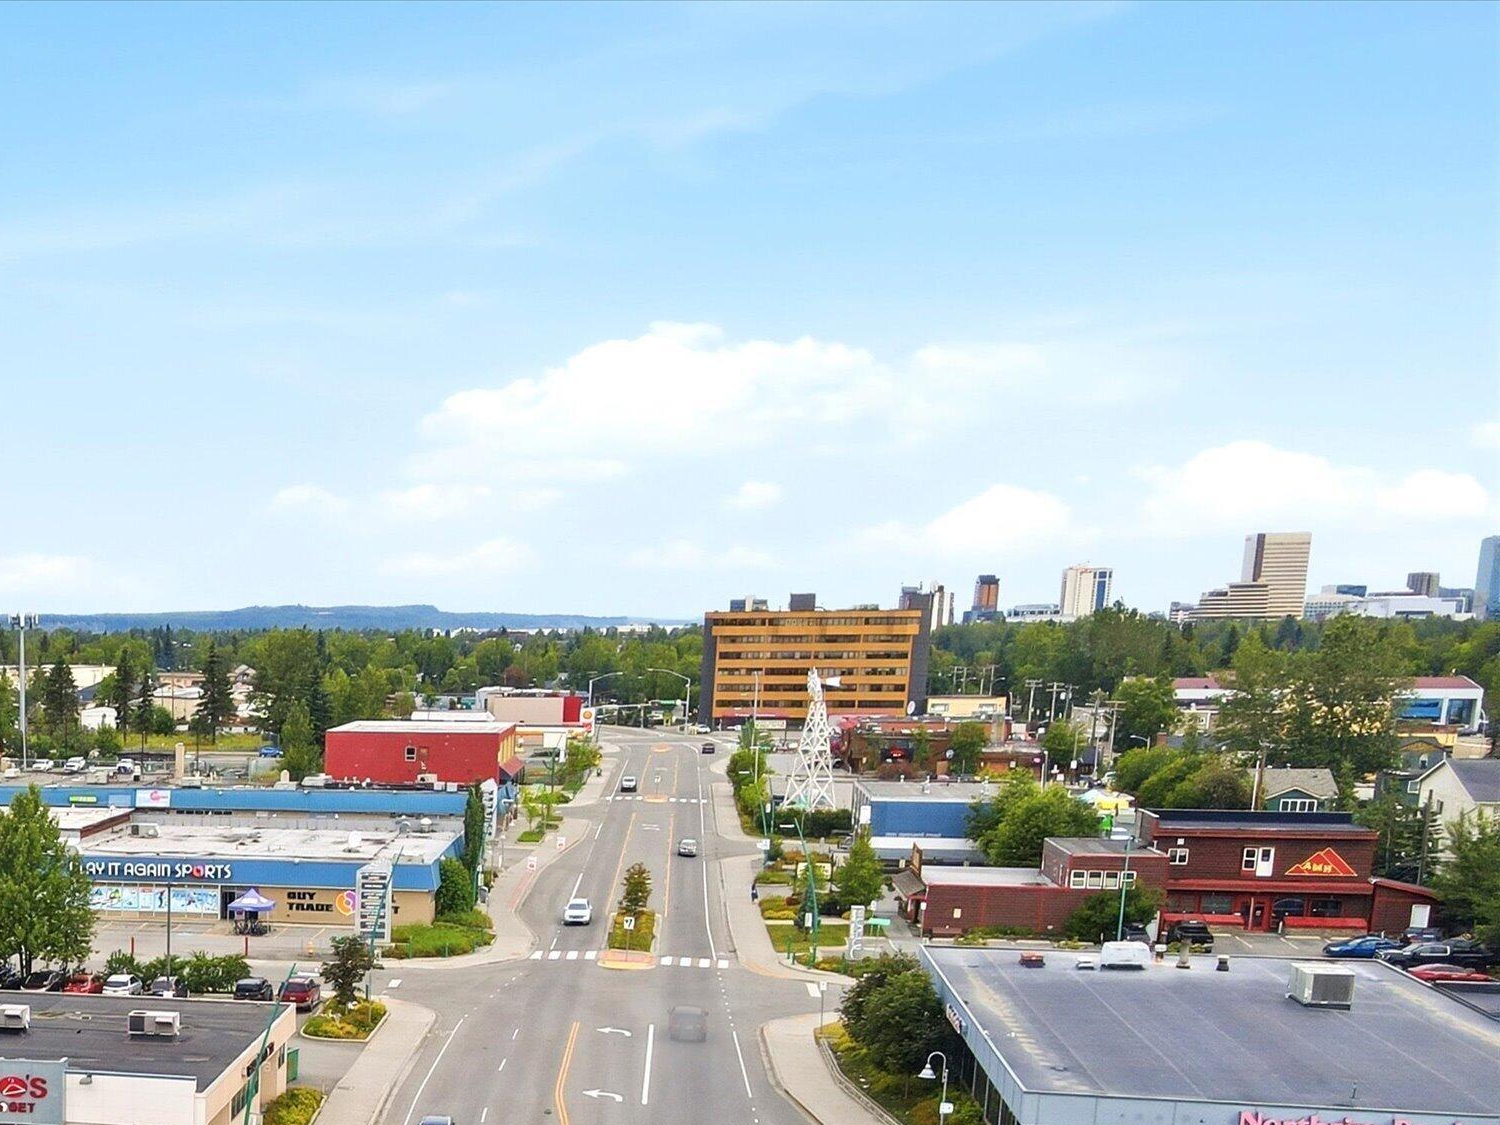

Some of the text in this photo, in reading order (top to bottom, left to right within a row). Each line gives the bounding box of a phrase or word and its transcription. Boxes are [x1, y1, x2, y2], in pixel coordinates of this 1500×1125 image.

[108, 862, 121, 876] IT
[124, 862, 171, 878] AGAIN
[174, 863, 232, 879] SPORTS
[1302, 862, 1333, 873] AMH
[286, 891, 316, 900] BUY
[286, 902, 334, 912] TRADE
